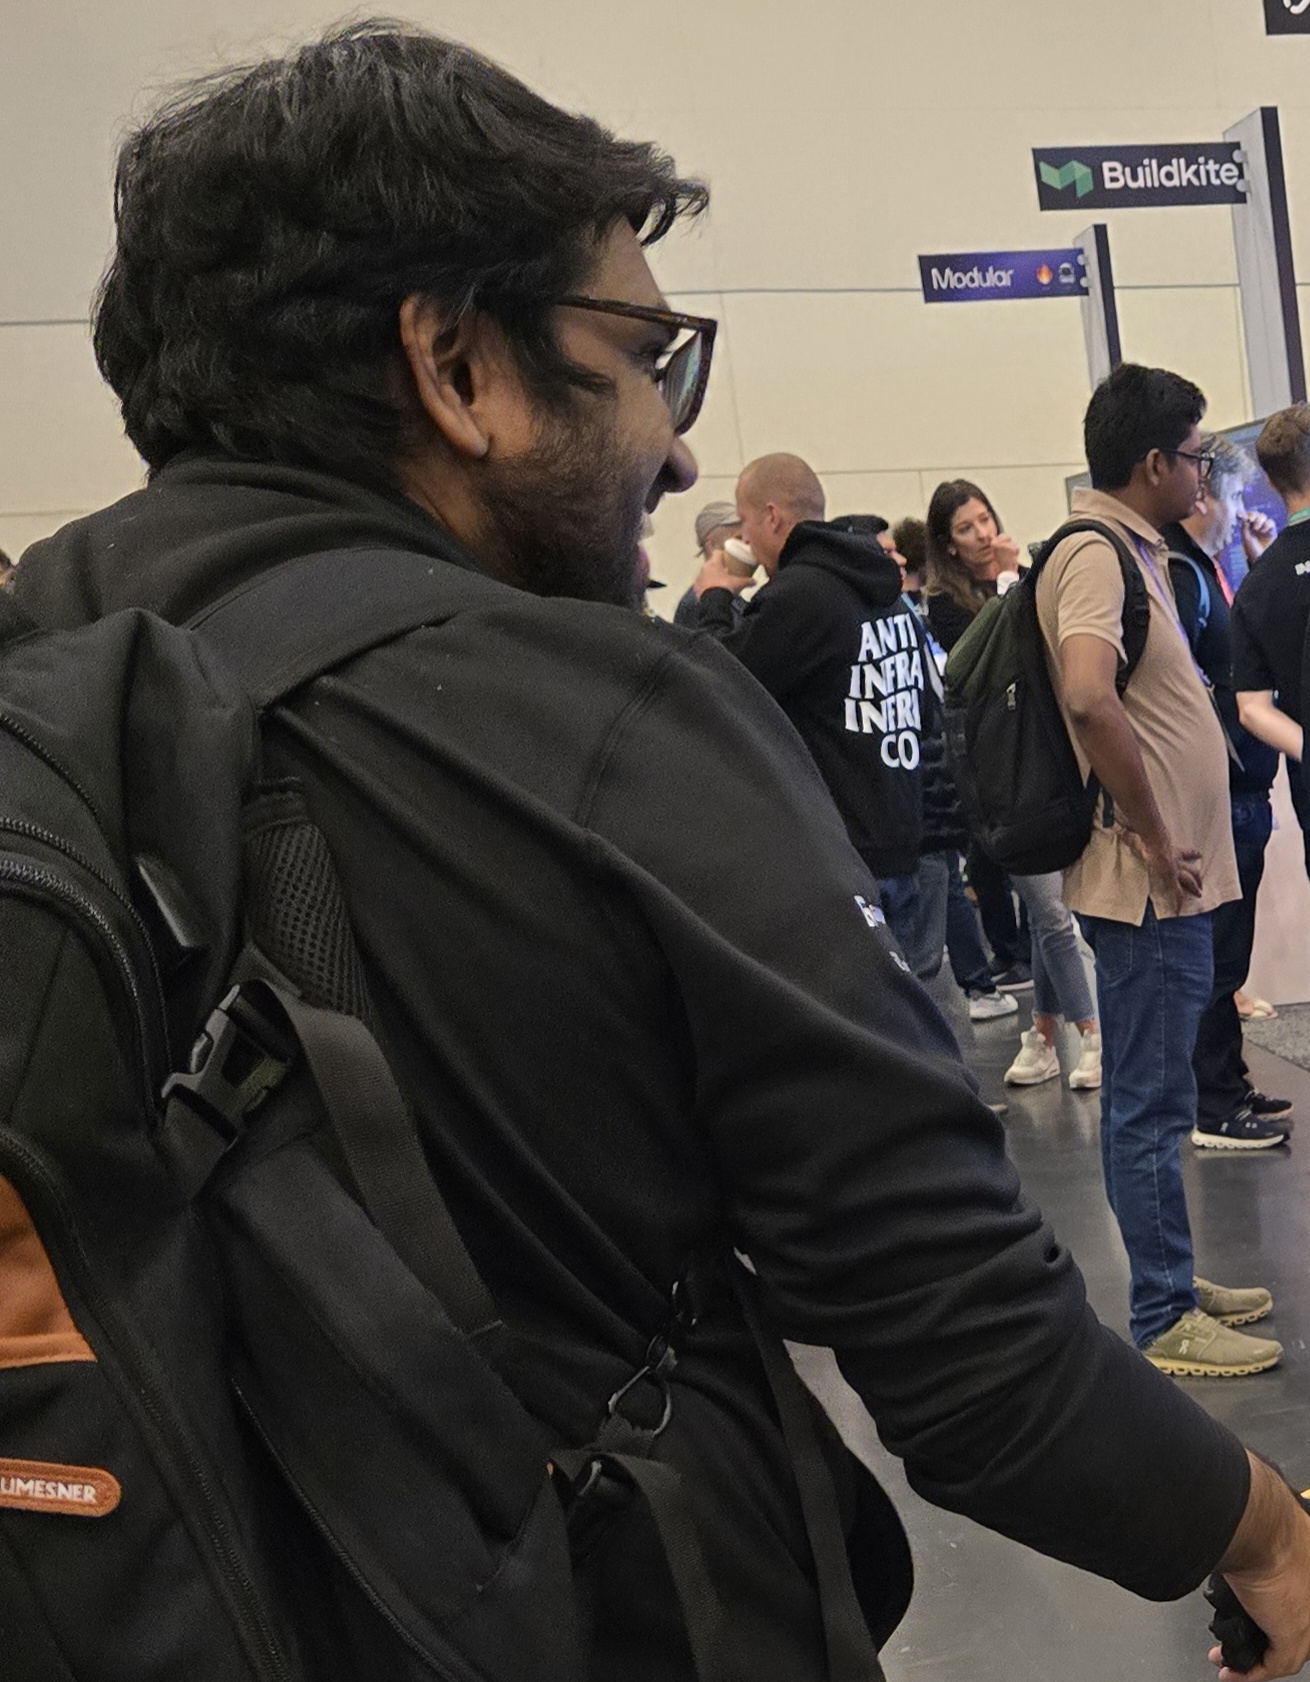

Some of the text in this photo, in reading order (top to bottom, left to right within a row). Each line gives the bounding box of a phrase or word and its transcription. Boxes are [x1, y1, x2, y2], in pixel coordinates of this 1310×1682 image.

[1102, 157, 1239, 190] Buildkite
[931, 266, 1013, 290] Modular
[858, 613, 918, 662] ANTI
[849, 650, 925, 699] INFRA
[844, 689, 922, 733] INFRI
[880, 730, 920, 770] CO
